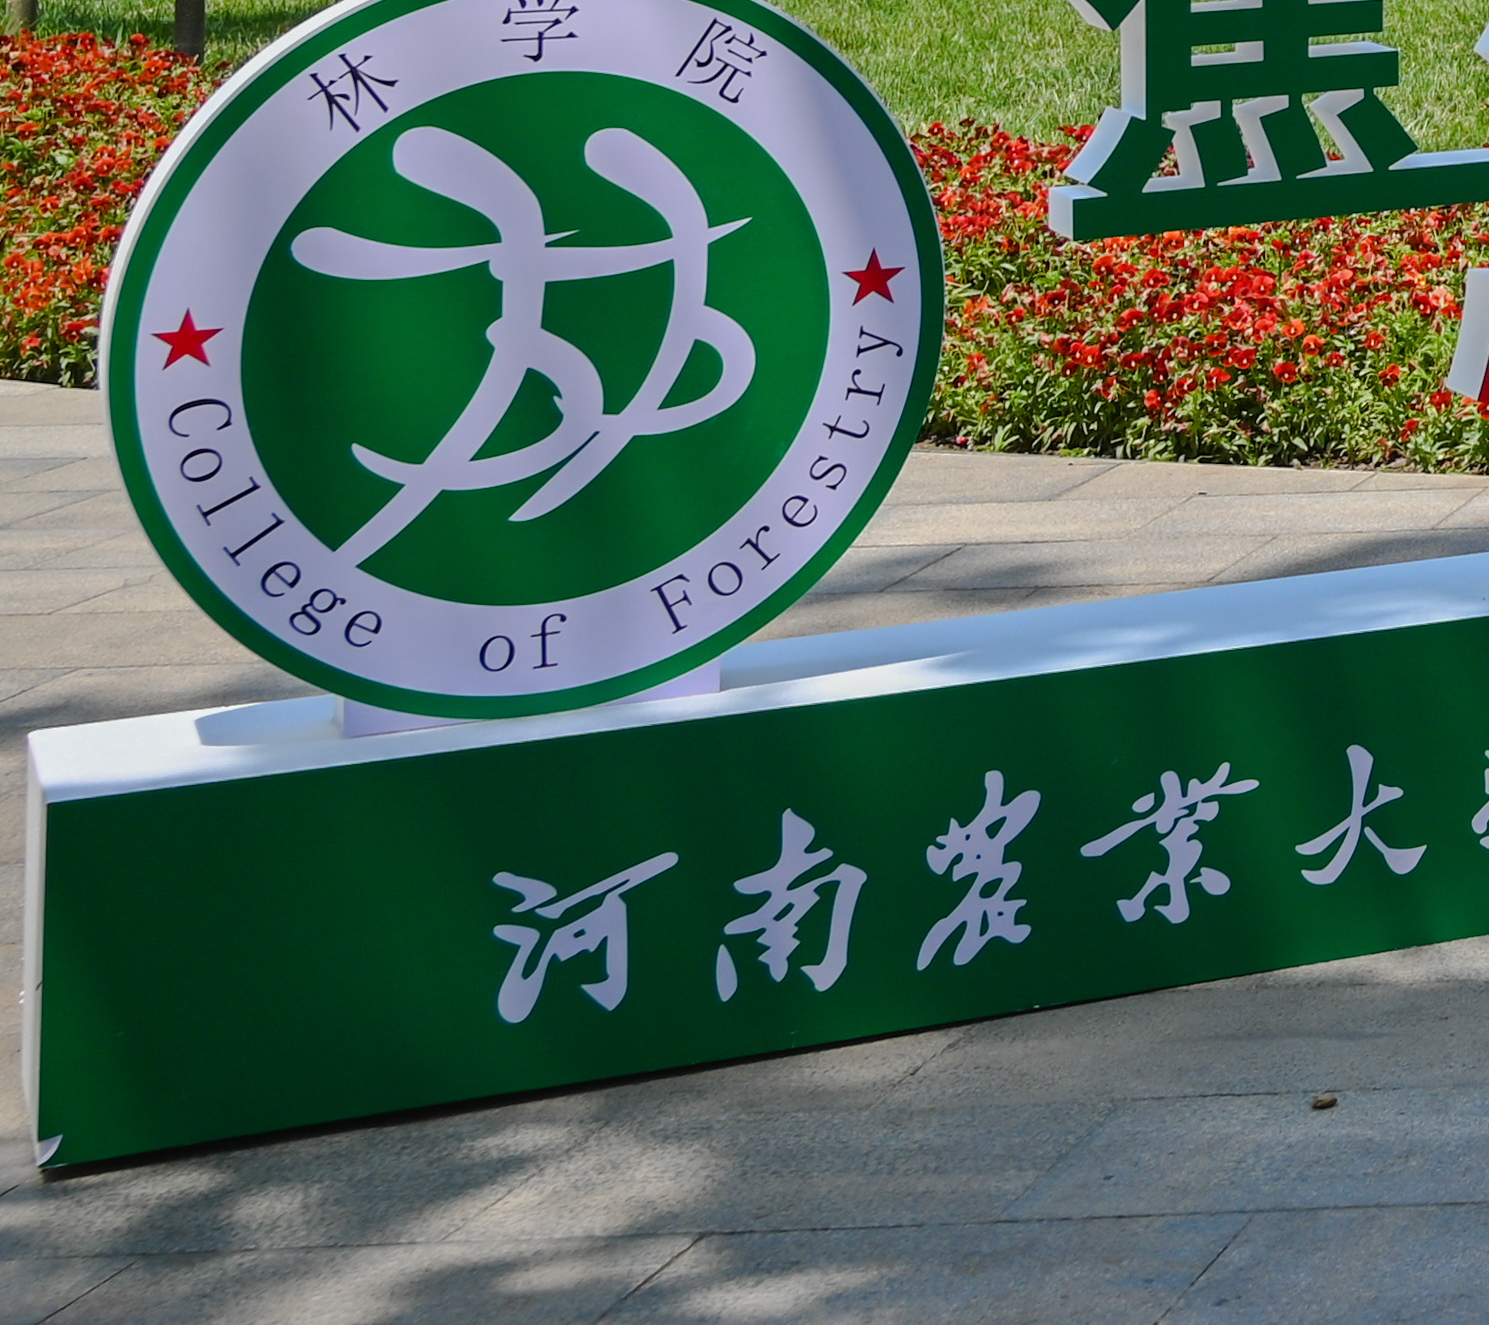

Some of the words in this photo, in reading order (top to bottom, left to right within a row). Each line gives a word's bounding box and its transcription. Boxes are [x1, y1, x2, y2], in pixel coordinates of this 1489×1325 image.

[168, 396, 385, 648] College
[478, 613, 568, 673] of
[650, 325, 904, 635] Forestry
